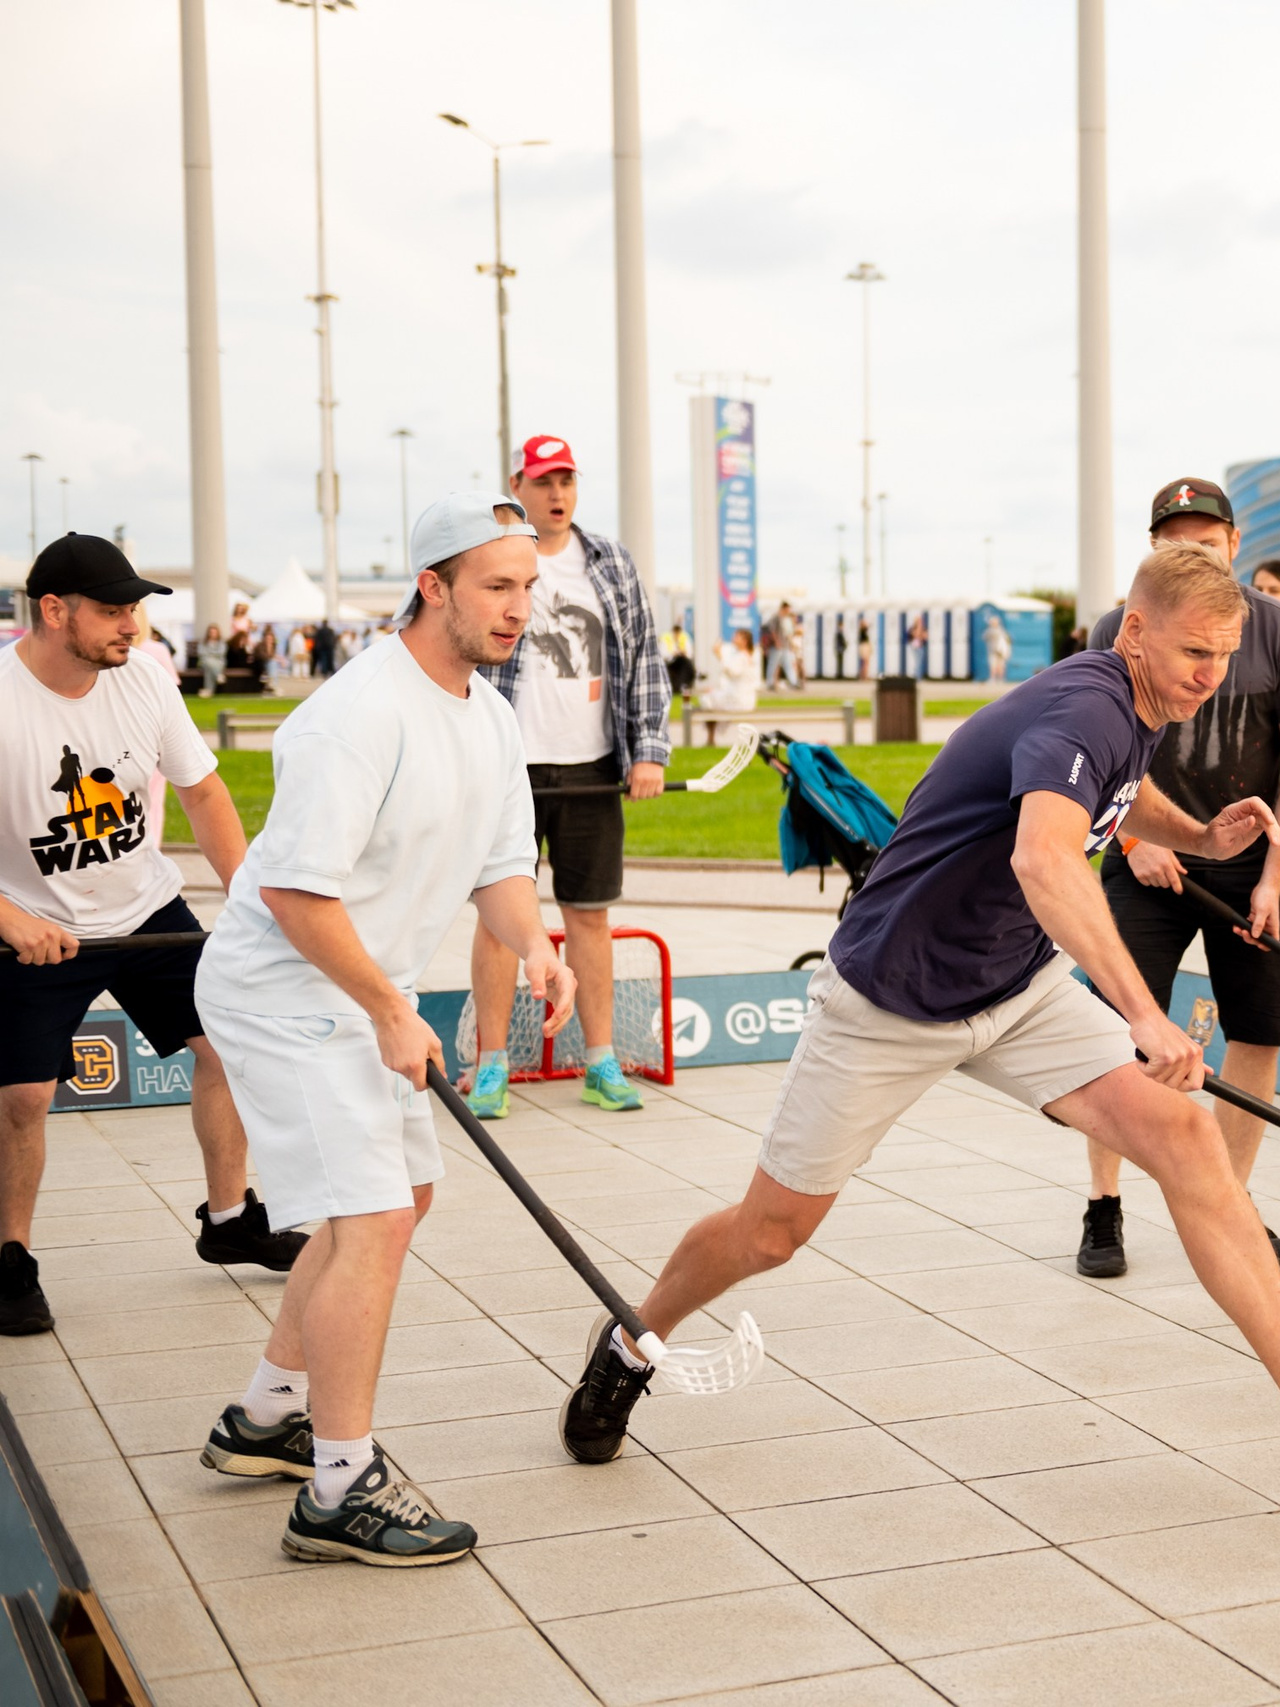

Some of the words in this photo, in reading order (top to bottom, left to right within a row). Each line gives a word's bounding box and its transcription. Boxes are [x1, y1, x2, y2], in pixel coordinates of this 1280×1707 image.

[1068, 752, 1085, 785] ZASPORT
[29, 791, 144, 848] STAR
[31, 812, 145, 876] WARS
[344, 1512, 385, 1540] N
